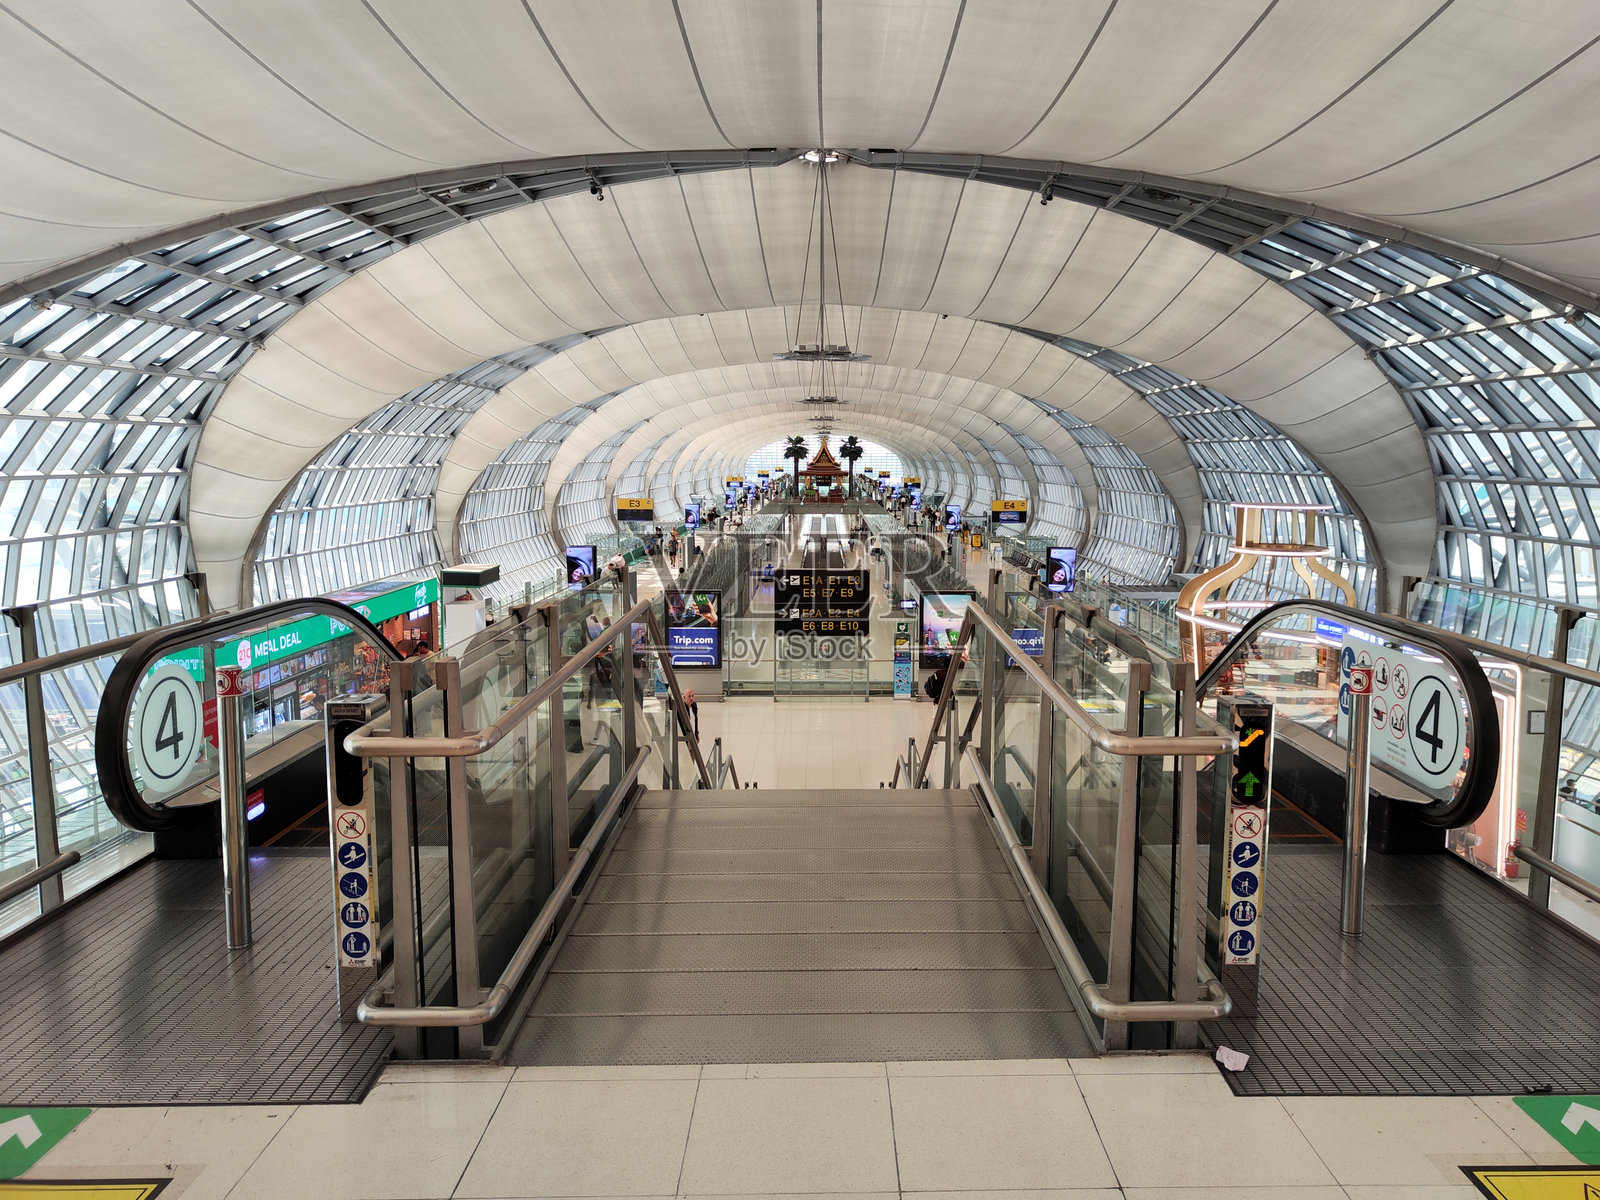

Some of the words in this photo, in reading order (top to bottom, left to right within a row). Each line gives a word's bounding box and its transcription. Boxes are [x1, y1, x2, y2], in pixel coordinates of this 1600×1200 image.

[629, 500, 640, 508] E3
[1004, 502, 1015, 510] E4
[802, 576, 823, 585] E1A
[829, 576, 840, 585] E1
[848, 576, 860, 585] E3
[803, 589, 816, 597] E5
[822, 589, 835, 597] E7
[841, 589, 853, 597] E9
[802, 609, 822, 618] E2A
[828, 609, 841, 618] E2
[847, 609, 860, 618] E4
[802, 622, 815, 630] E6
[821, 622, 834, 630] E8
[840, 622, 859, 630] E10
[254, 638, 279, 658] MEAL
[280, 631, 302, 650] DEAL
[674, 635, 714, 645] Trip.com
[156, 690, 184, 760] 4
[1416, 689, 1443, 764] 4
